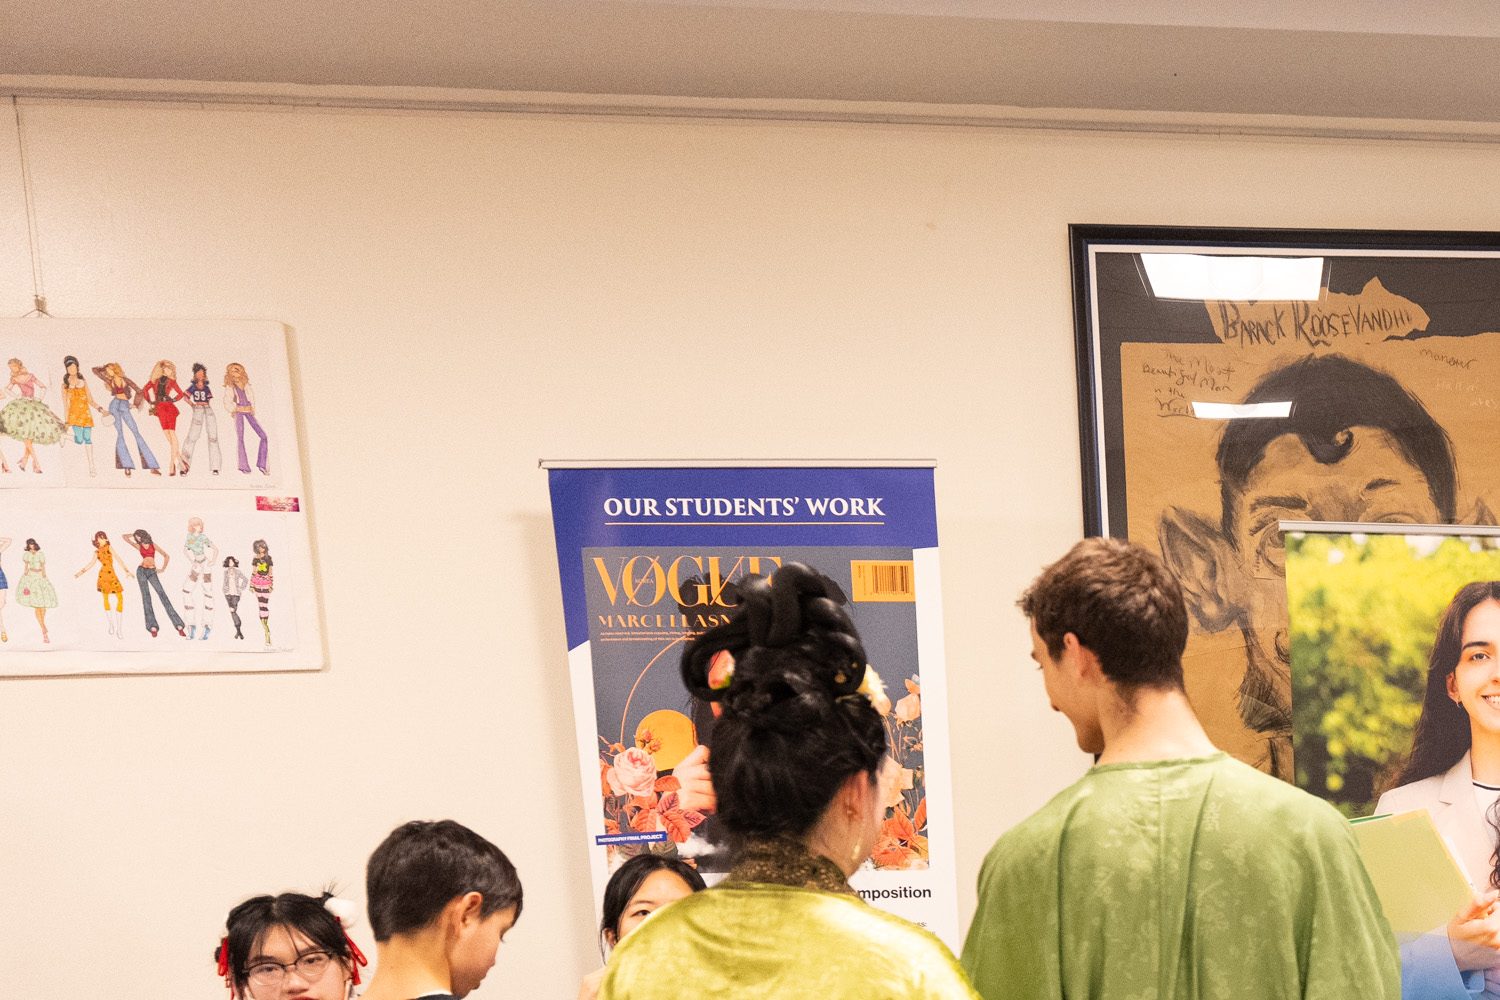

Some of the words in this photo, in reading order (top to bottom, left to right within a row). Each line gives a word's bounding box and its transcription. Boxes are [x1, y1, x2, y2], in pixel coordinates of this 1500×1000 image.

[603, 497, 661, 516] OUR
[665, 497, 799, 517] STUDENTS’
[805, 497, 886, 516] WORK
